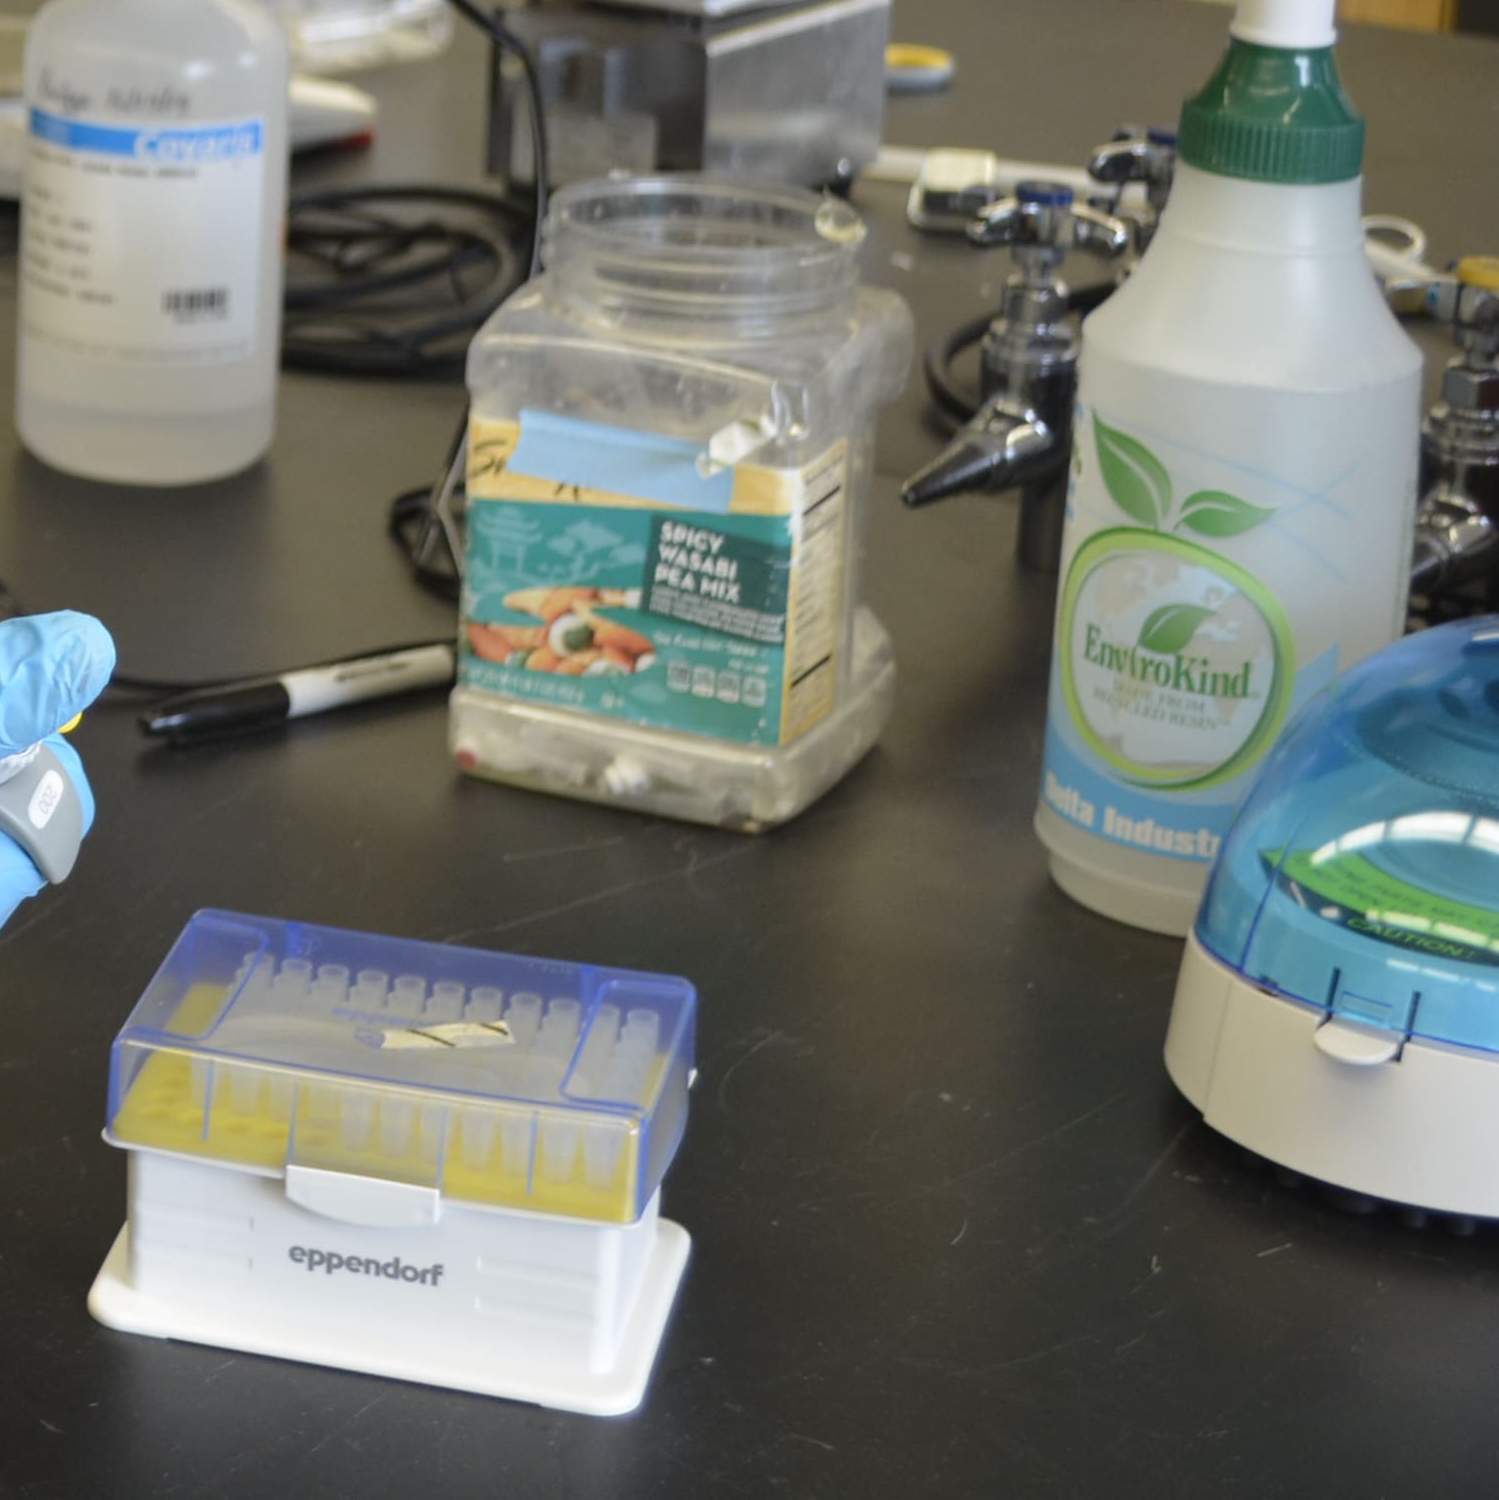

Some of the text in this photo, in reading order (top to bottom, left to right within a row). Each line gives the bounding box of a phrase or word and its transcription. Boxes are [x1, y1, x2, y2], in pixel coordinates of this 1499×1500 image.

[660, 520, 725, 554] SPICY
[658, 542, 739, 581] WASABI
[654, 562, 741, 604] PEA MIX
[1083, 621, 1252, 699] EnviroKind
[288, 1244, 444, 1287] eppendorf
